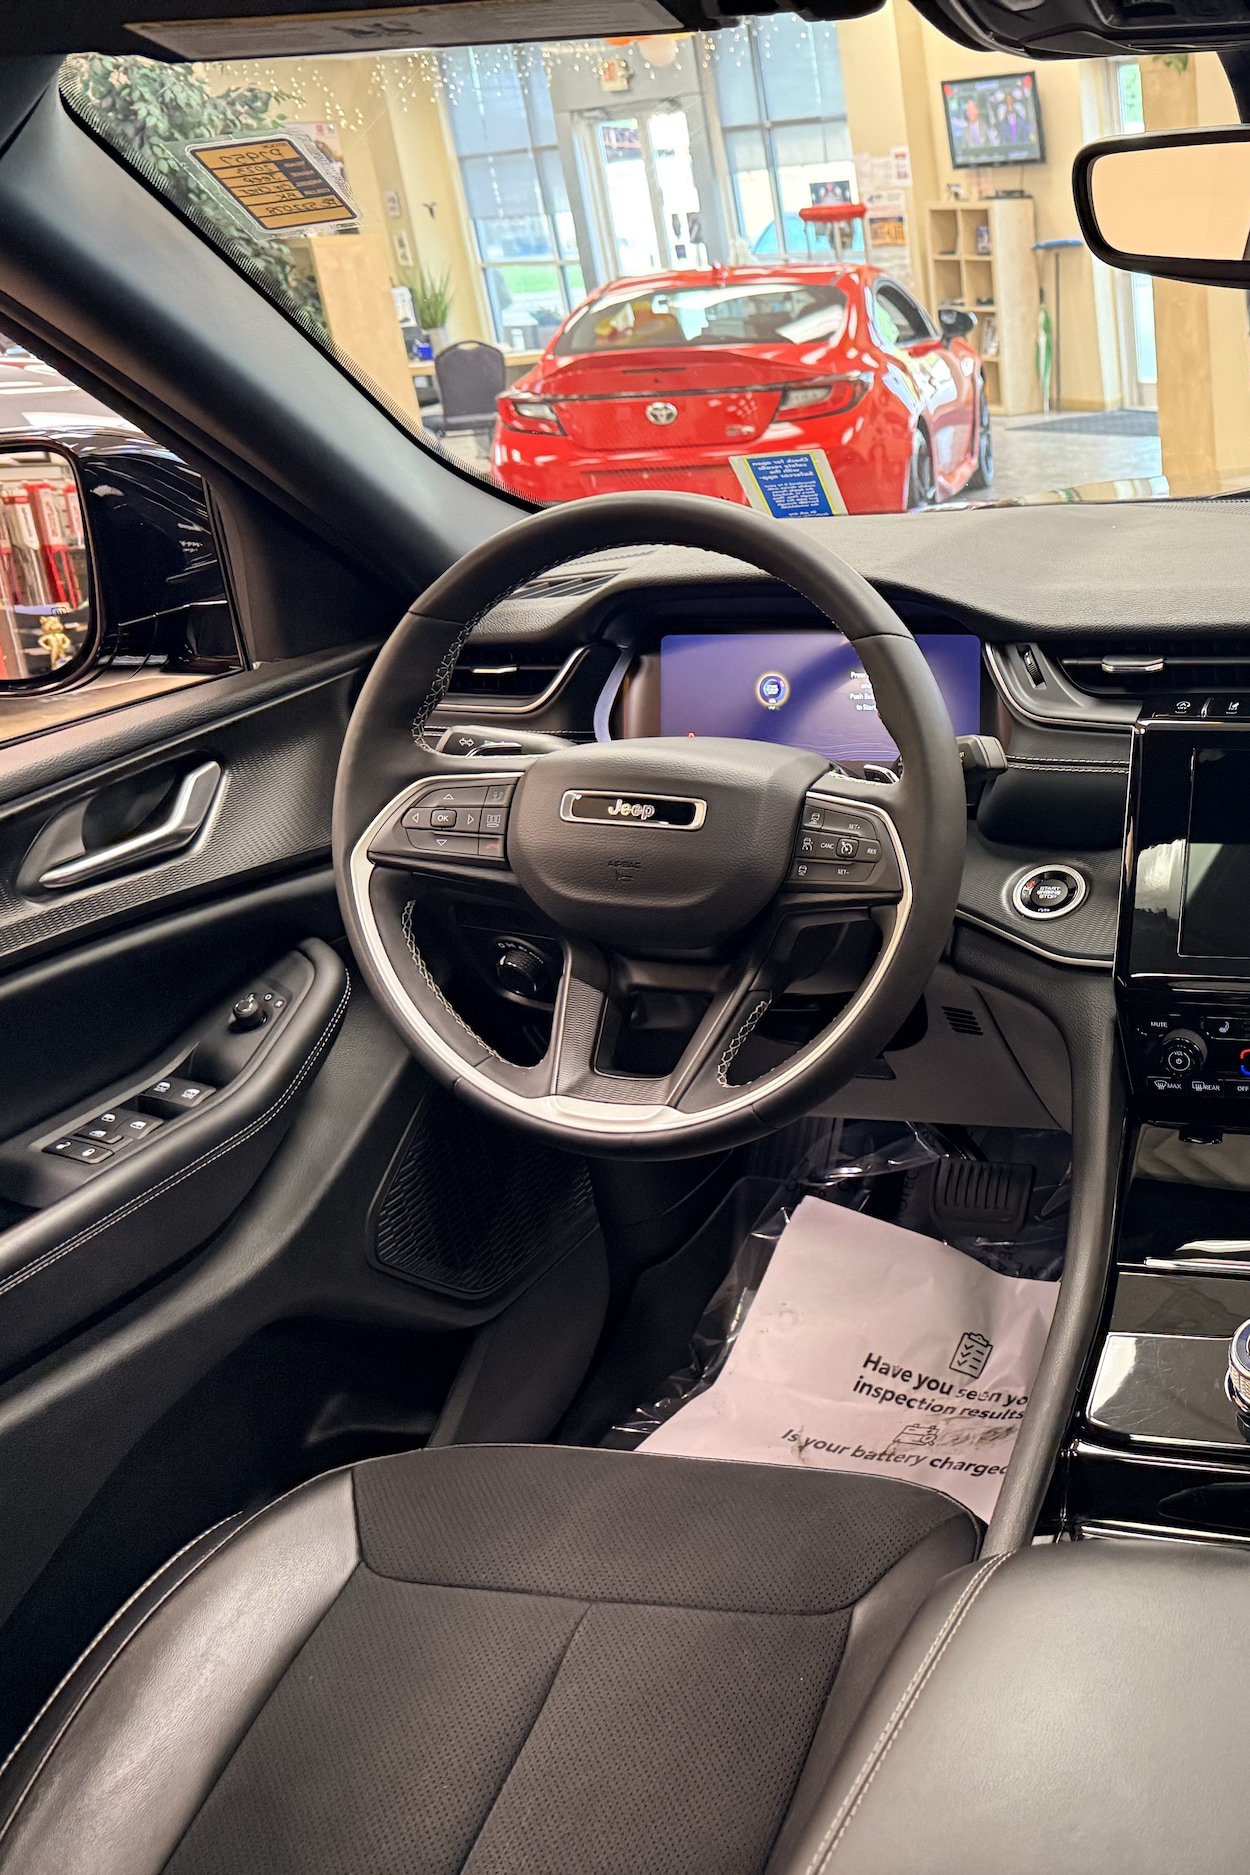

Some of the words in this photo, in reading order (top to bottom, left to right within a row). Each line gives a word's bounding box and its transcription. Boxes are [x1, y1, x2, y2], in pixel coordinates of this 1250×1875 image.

[437, 814, 449, 822] OK
[608, 799, 655, 820] Jeep
[820, 842, 835, 850] CANC
[862, 1352, 913, 1383] Have
[913, 1373, 955, 1397] you
[956, 1387, 1002, 1404] seen
[1002, 1395, 1029, 1408] yo
[852, 1375, 957, 1416] inspection
[781, 1428, 800, 1443] Is
[797, 1434, 853, 1456] your
[851, 1445, 929, 1467] battery
